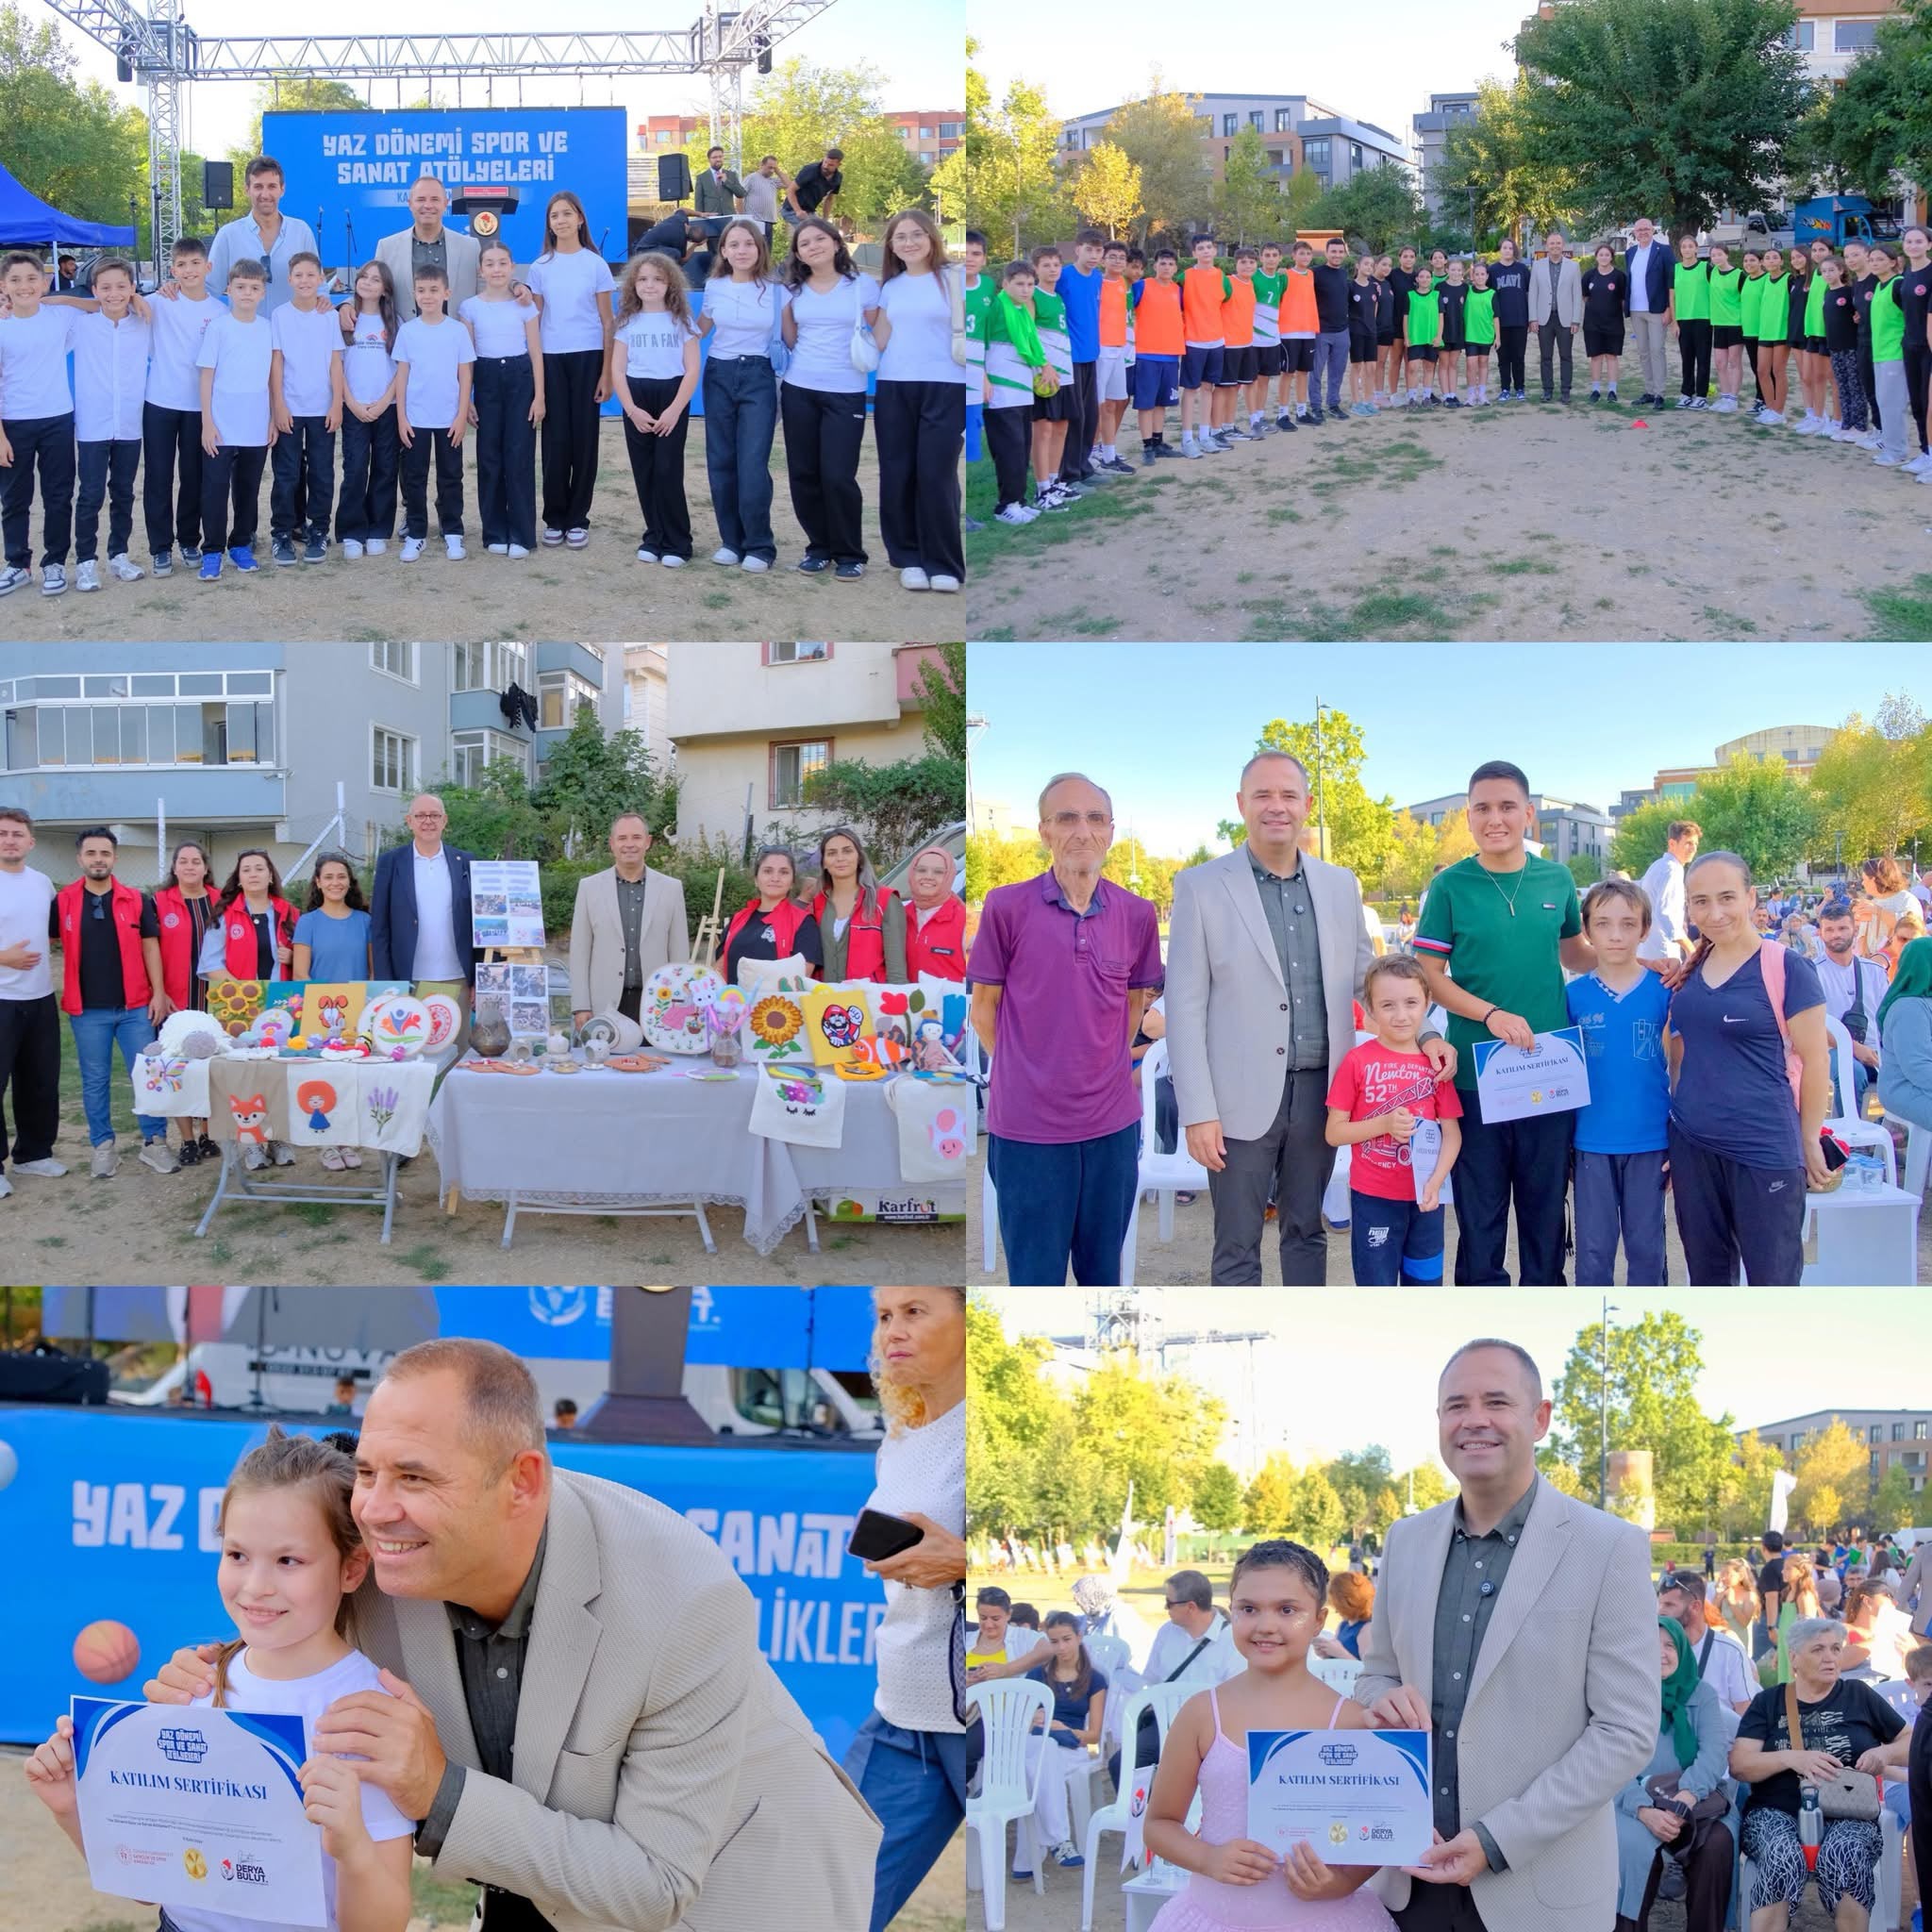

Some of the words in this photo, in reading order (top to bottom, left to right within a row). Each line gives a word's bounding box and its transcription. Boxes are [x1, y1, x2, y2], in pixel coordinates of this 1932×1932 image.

[323, 134, 367, 157] YAZ
[375, 127, 462, 156] DÖNEMİ
[471, 131, 529, 154] SPOR
[539, 130, 568, 153] VE
[338, 161, 410, 184] SANAT
[419, 155, 555, 182] ATÖLYELERİ
[1267, 291, 1274, 303] 7
[1058, 314, 1066, 329] 5
[1365, 1061, 1421, 1085] Newton
[72, 1480, 186, 1550] YAZ
[110, 1771, 170, 1790] KATILIM
[175, 1777, 267, 1800] SERTİFİKASI
[1279, 1774, 1325, 1785] KATILIM
[1329, 1774, 1399, 1785] SERTİFİKASI
[236, 1863, 264, 1874] DERYA
